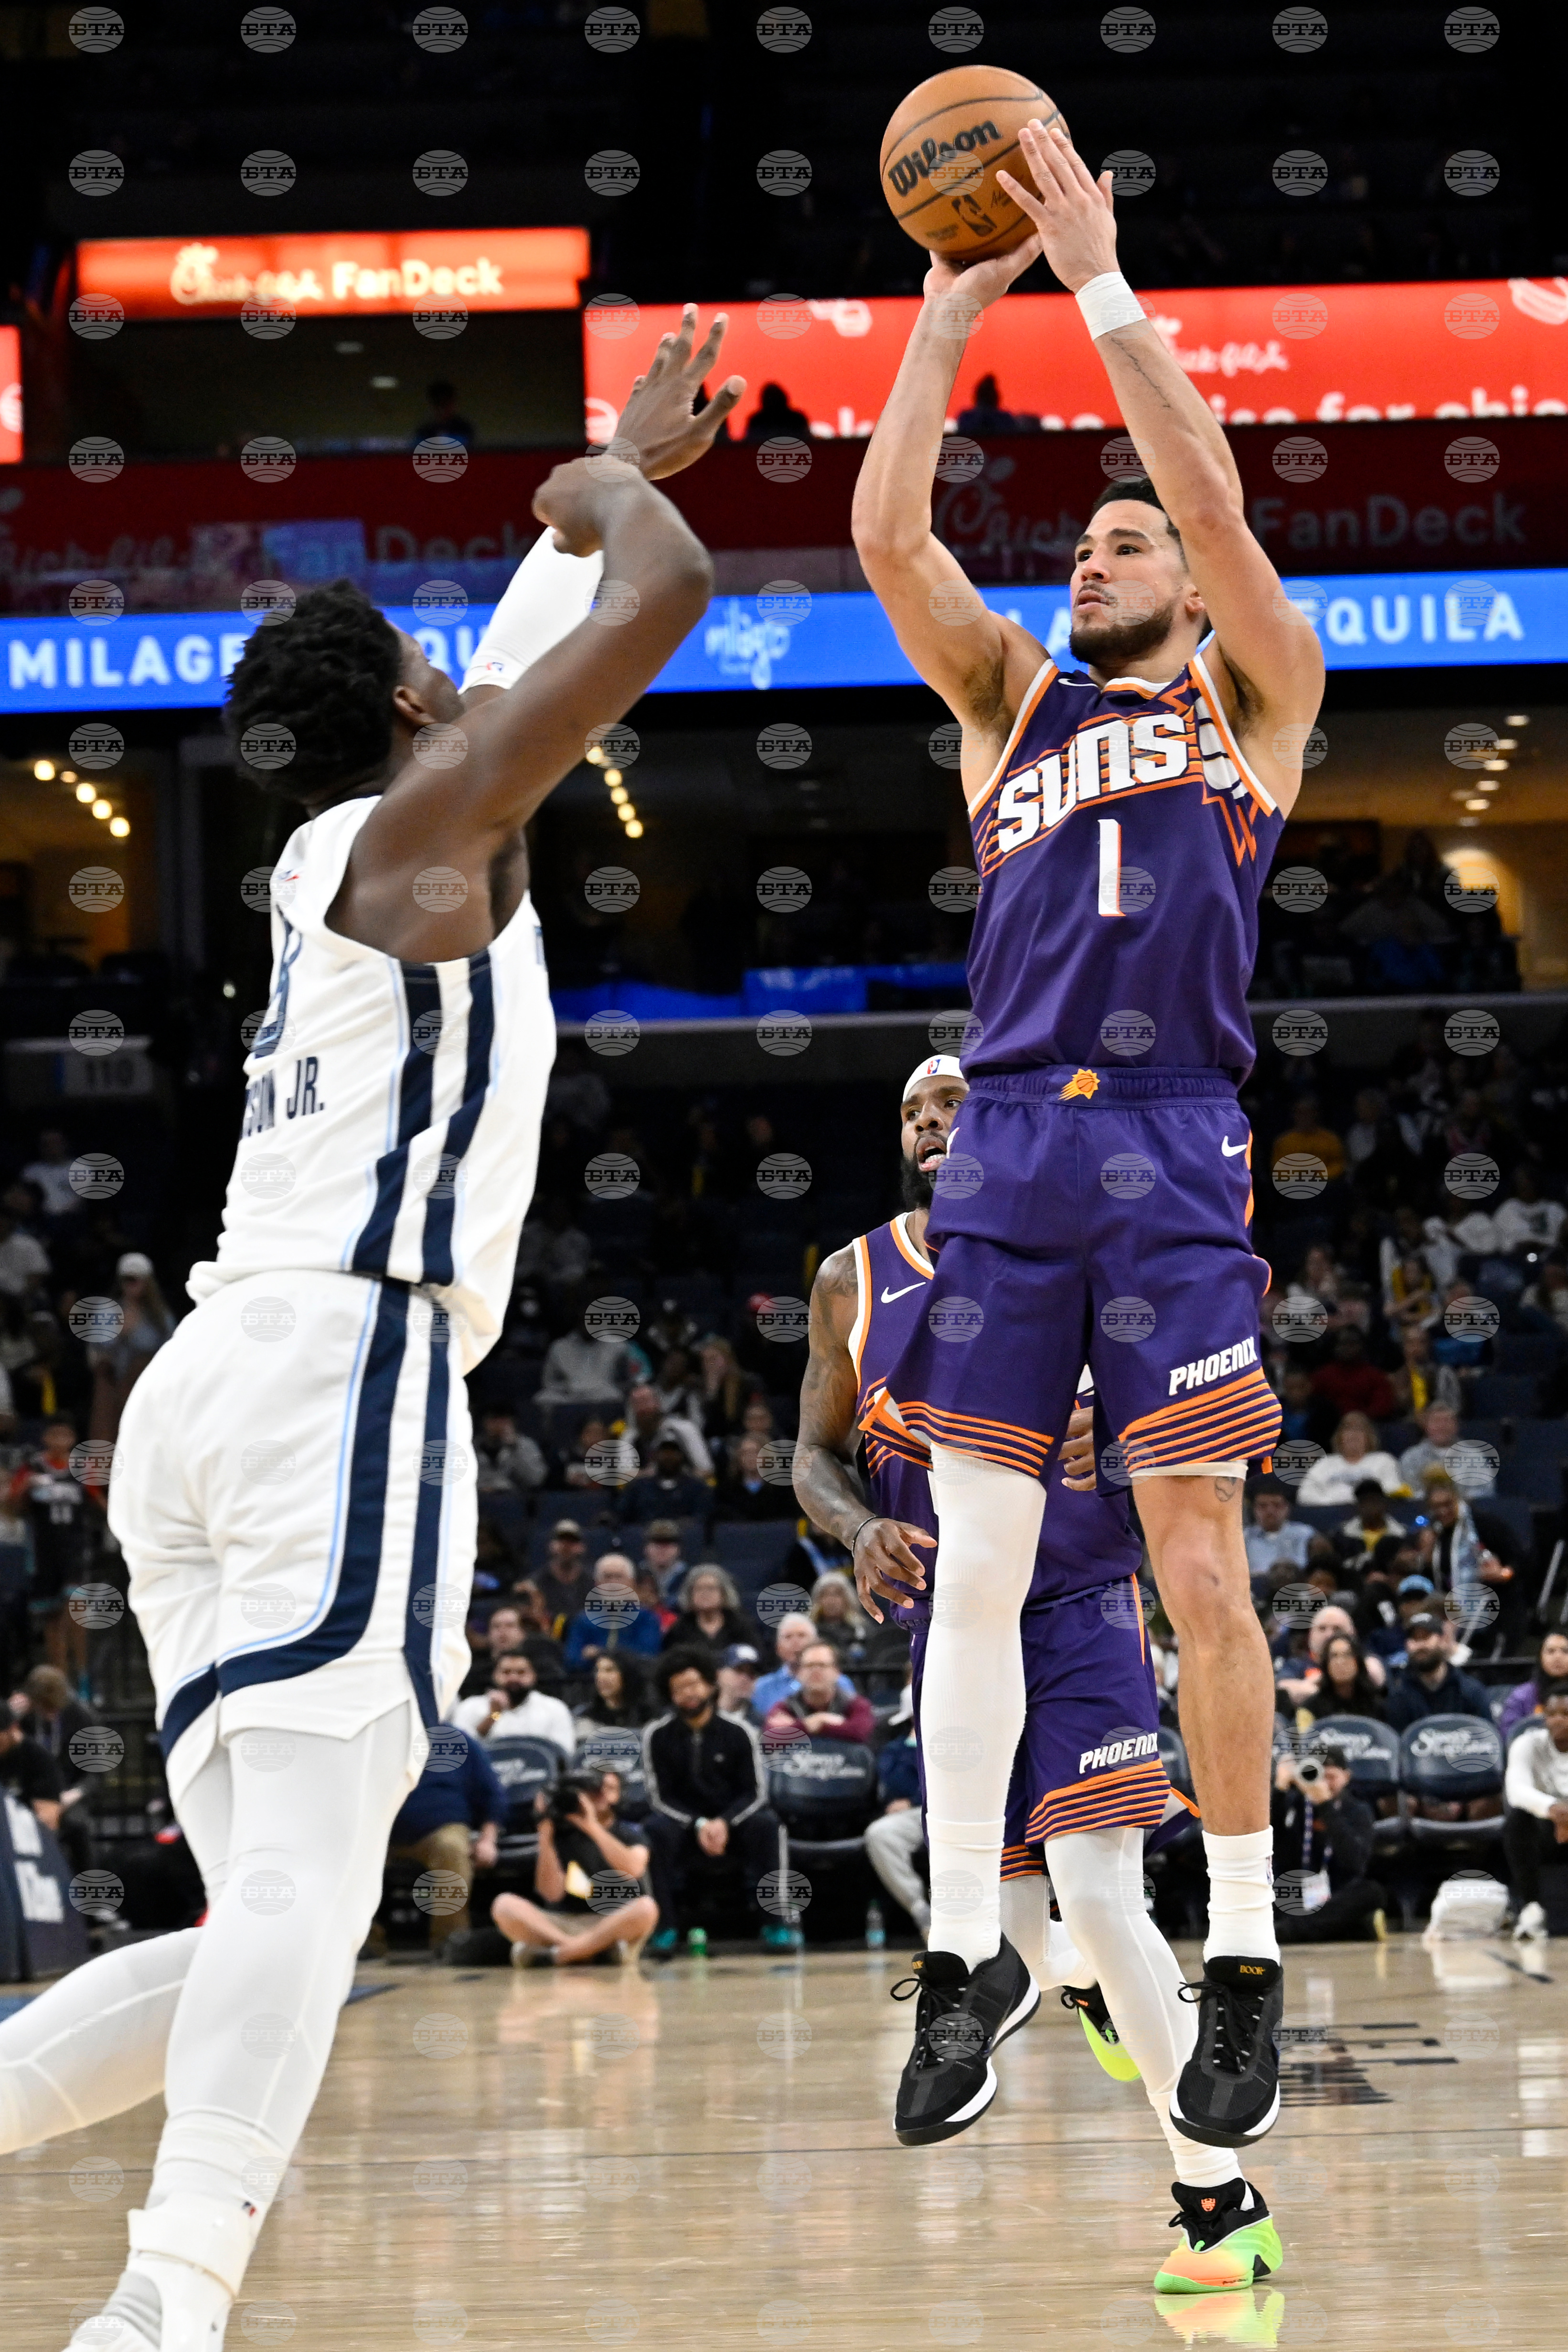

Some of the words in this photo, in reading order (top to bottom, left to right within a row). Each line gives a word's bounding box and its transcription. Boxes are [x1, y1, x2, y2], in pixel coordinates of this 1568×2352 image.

[888, 120, 1002, 197] Wilson
[332, 257, 502, 299] FanDeck
[1250, 491, 1527, 551] FanDeck
[998, 714, 1187, 853] SUNS
[1098, 818, 1126, 917] 1
[287, 1056, 325, 1120] JR.
[1169, 1336, 1258, 1396] PHOENIX
[1079, 1732, 1158, 1775] PHOENIX
